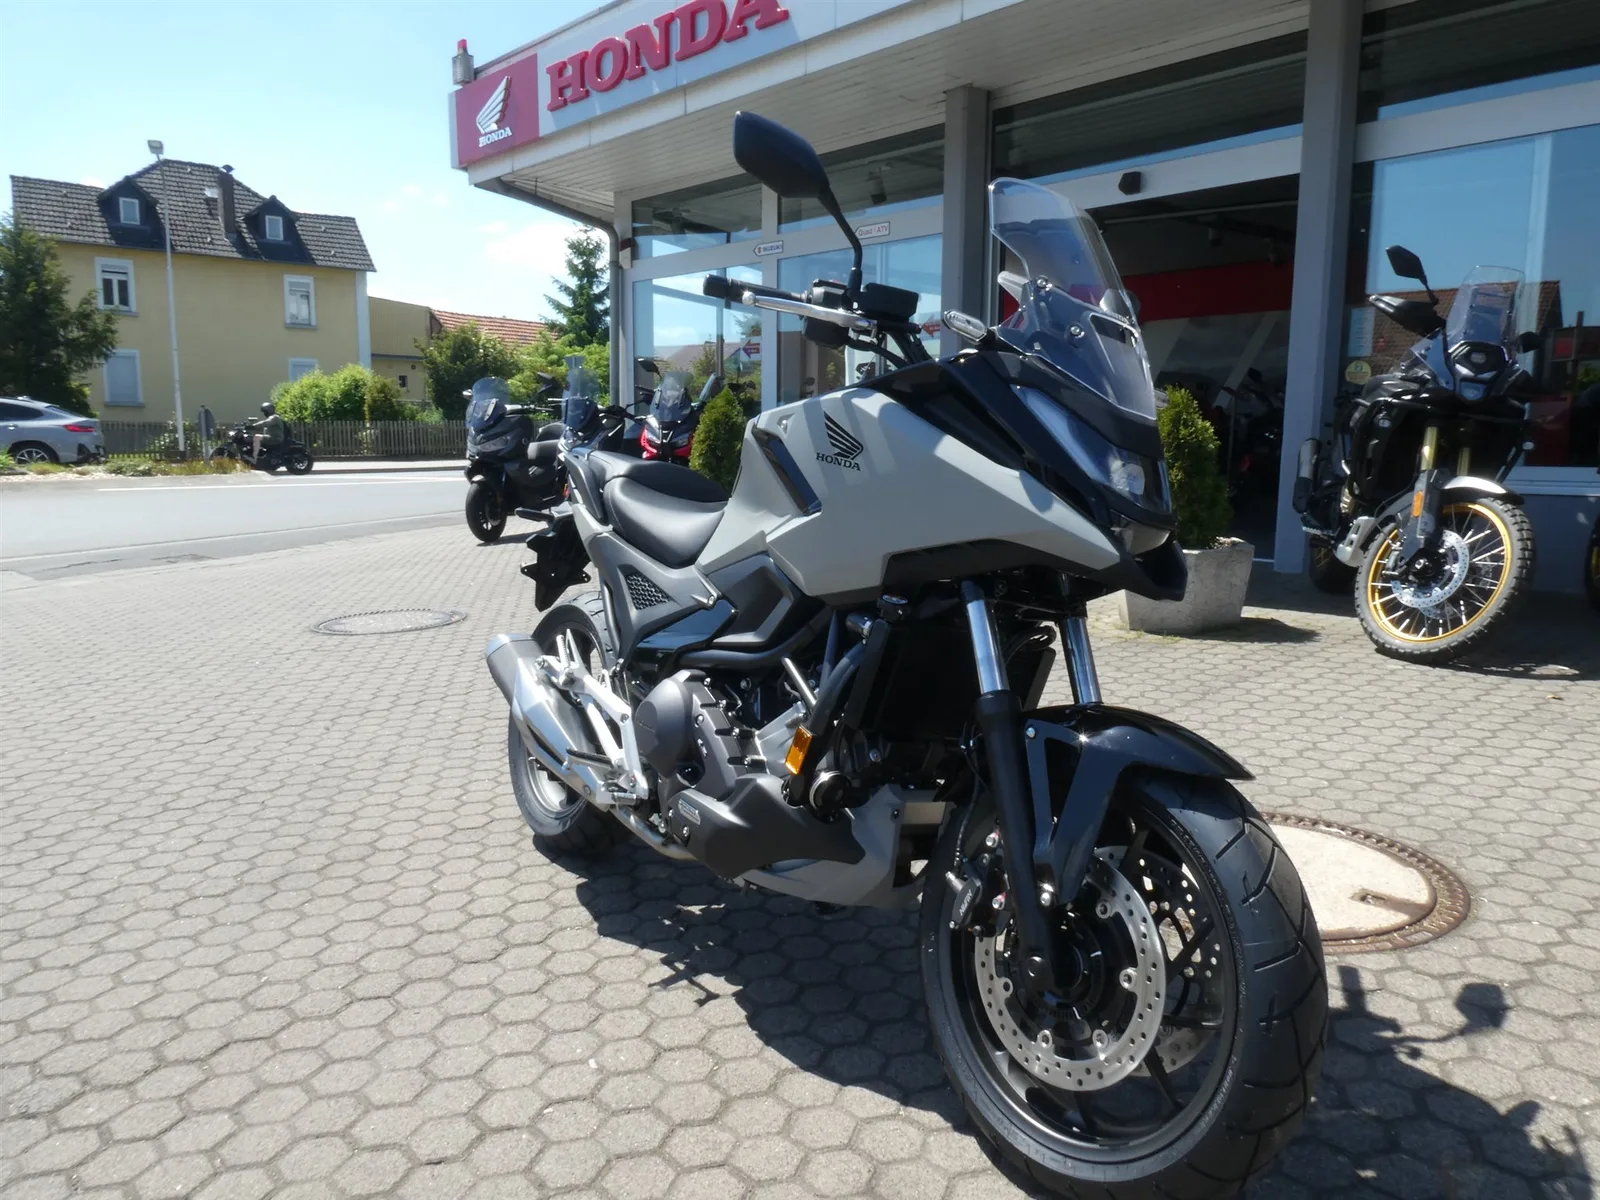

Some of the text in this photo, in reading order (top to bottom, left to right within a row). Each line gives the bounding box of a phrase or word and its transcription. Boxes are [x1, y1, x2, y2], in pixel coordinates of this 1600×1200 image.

[546, 0, 789, 112] HONDA
[478, 126, 513, 148] HONDA
[815, 452, 861, 471] HONDA
